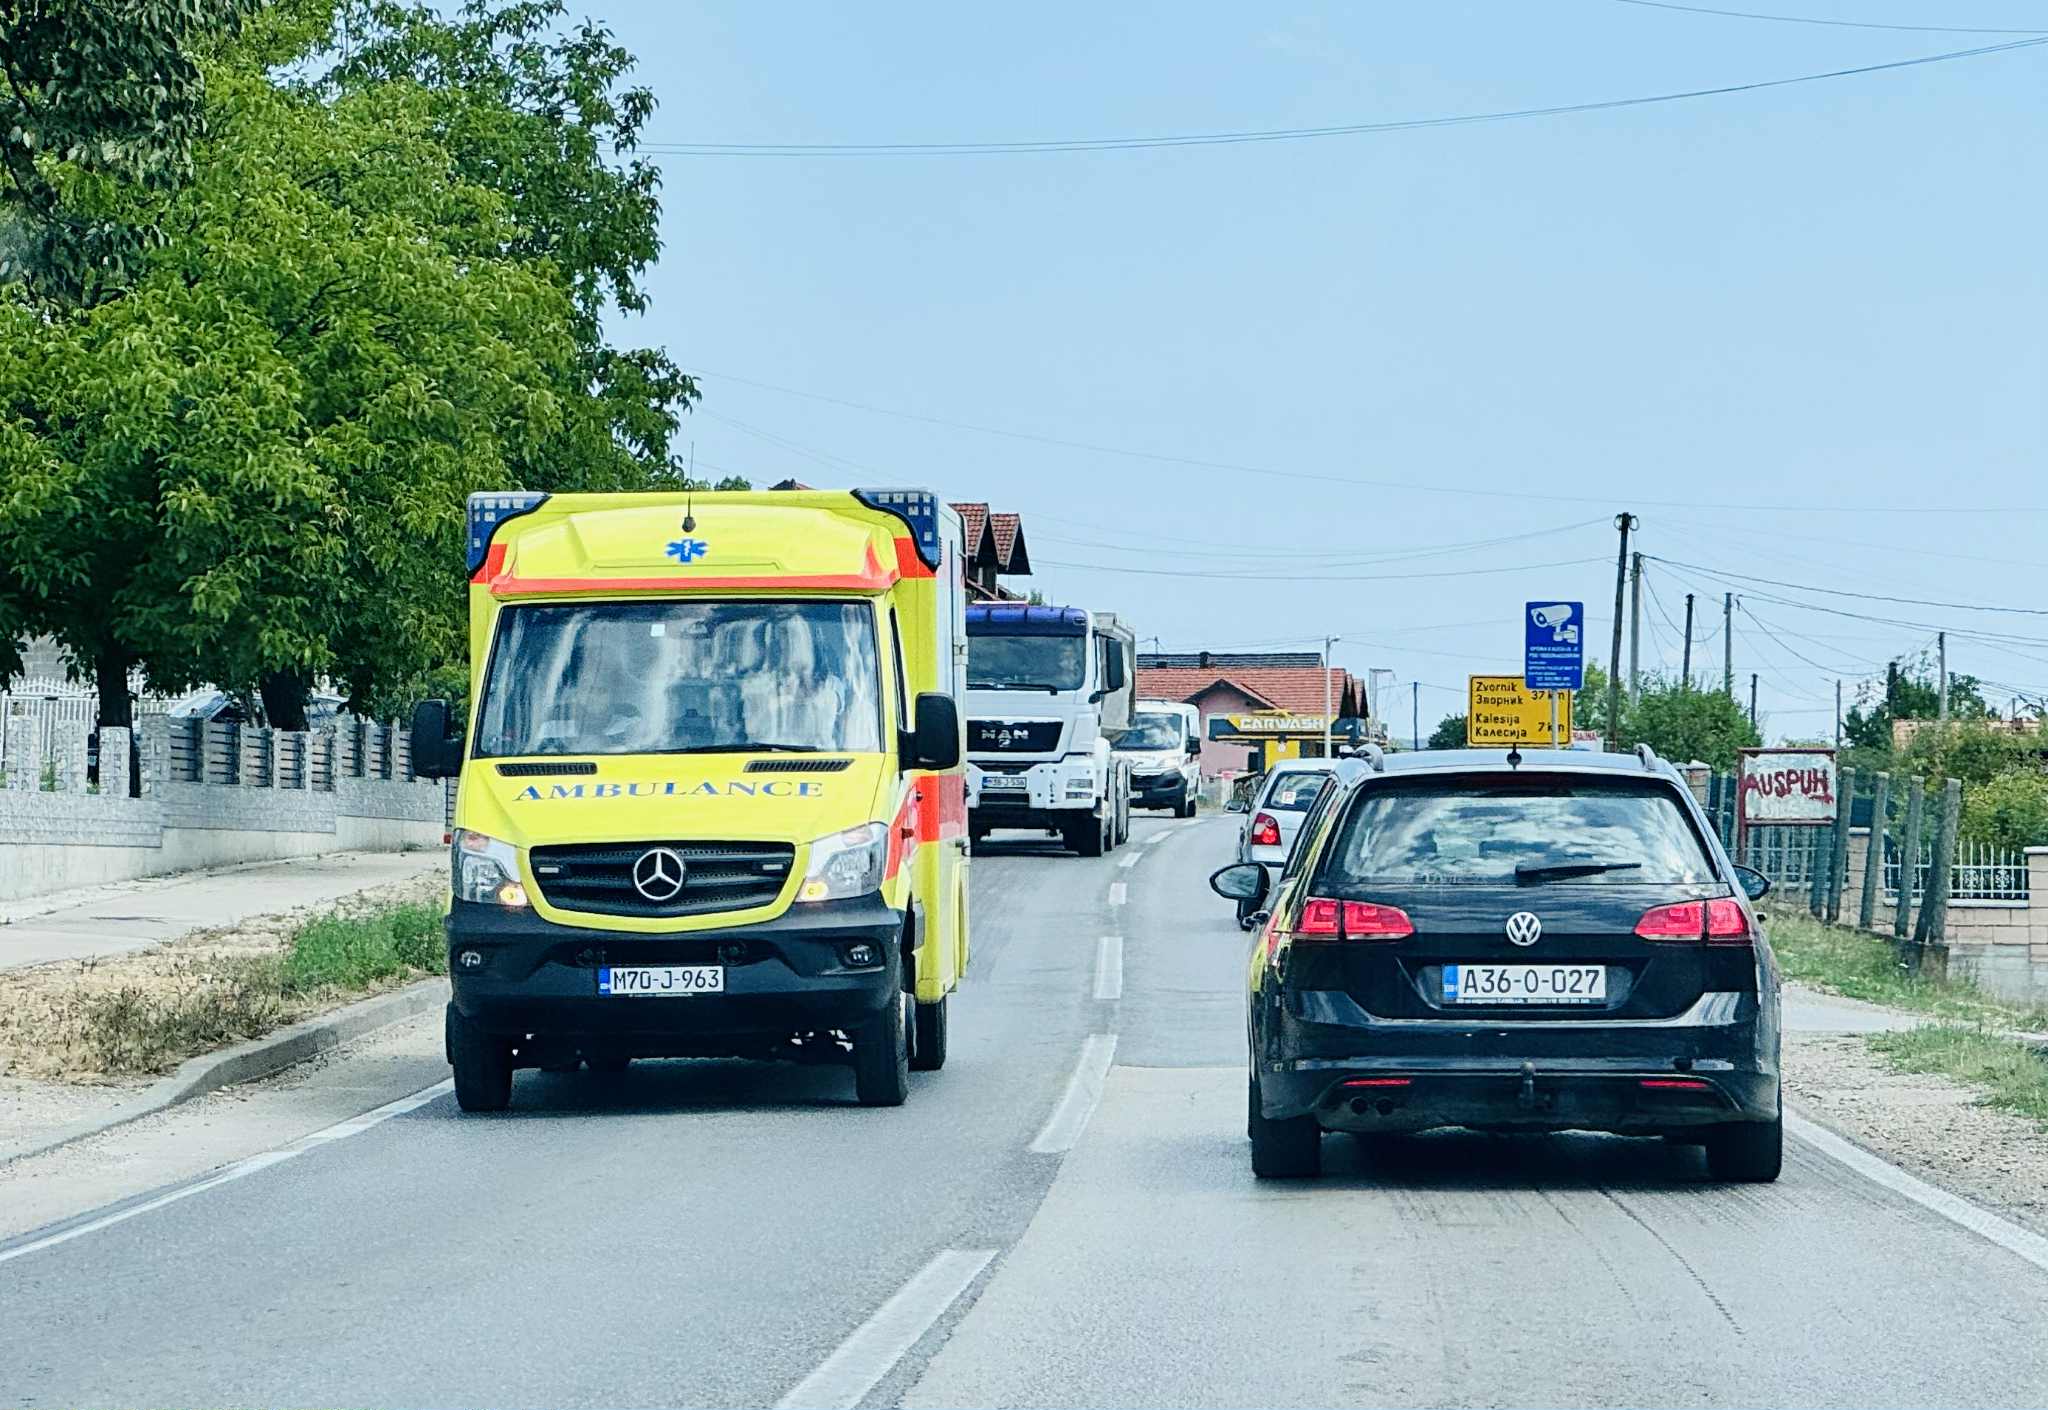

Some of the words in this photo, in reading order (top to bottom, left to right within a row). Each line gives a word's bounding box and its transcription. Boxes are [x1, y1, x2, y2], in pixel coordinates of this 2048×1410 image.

[1476, 681, 1517, 692] Zvornik
[1531, 690, 1544, 700] 37
[1475, 713, 1520, 726] Kalesija
[1475, 726, 1527, 739] Калесија
[1538, 722, 1545, 732] 7
[982, 729, 1029, 739] MAN
[1744, 768, 1829, 798] AUSPUH
[513, 781, 823, 801] AMBULANCE
[614, 970, 719, 990] M70-J-963
